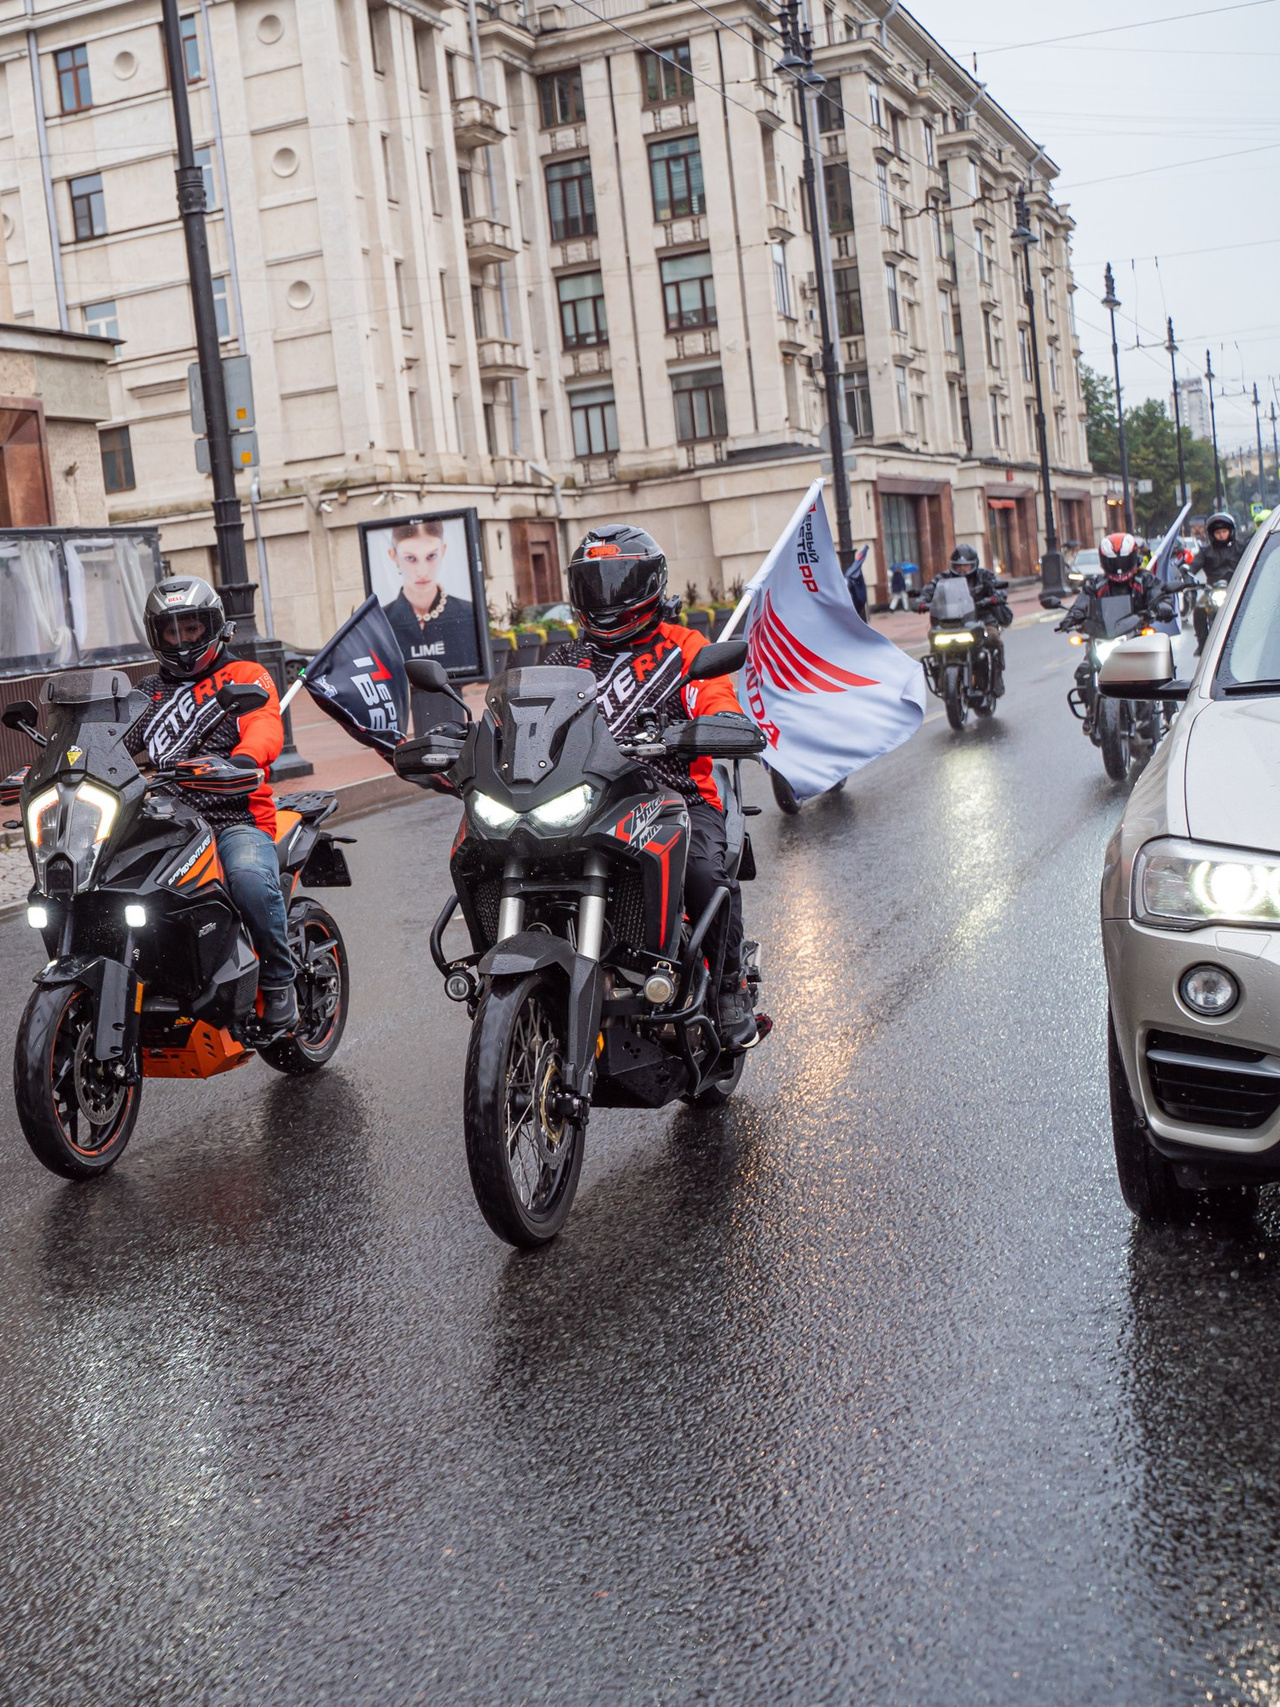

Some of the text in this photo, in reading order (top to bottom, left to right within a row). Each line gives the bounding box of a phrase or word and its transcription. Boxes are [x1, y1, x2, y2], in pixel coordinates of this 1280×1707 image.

[590, 546, 617, 557] SHOEI
[797, 518, 819, 593] ЕТЕРР
[411, 641, 446, 658] LIME
[746, 640, 782, 751] NDA
[629, 795, 665, 845] Africa
[181, 834, 211, 876] ADVENTURE
[198, 922, 217, 938] KTM
